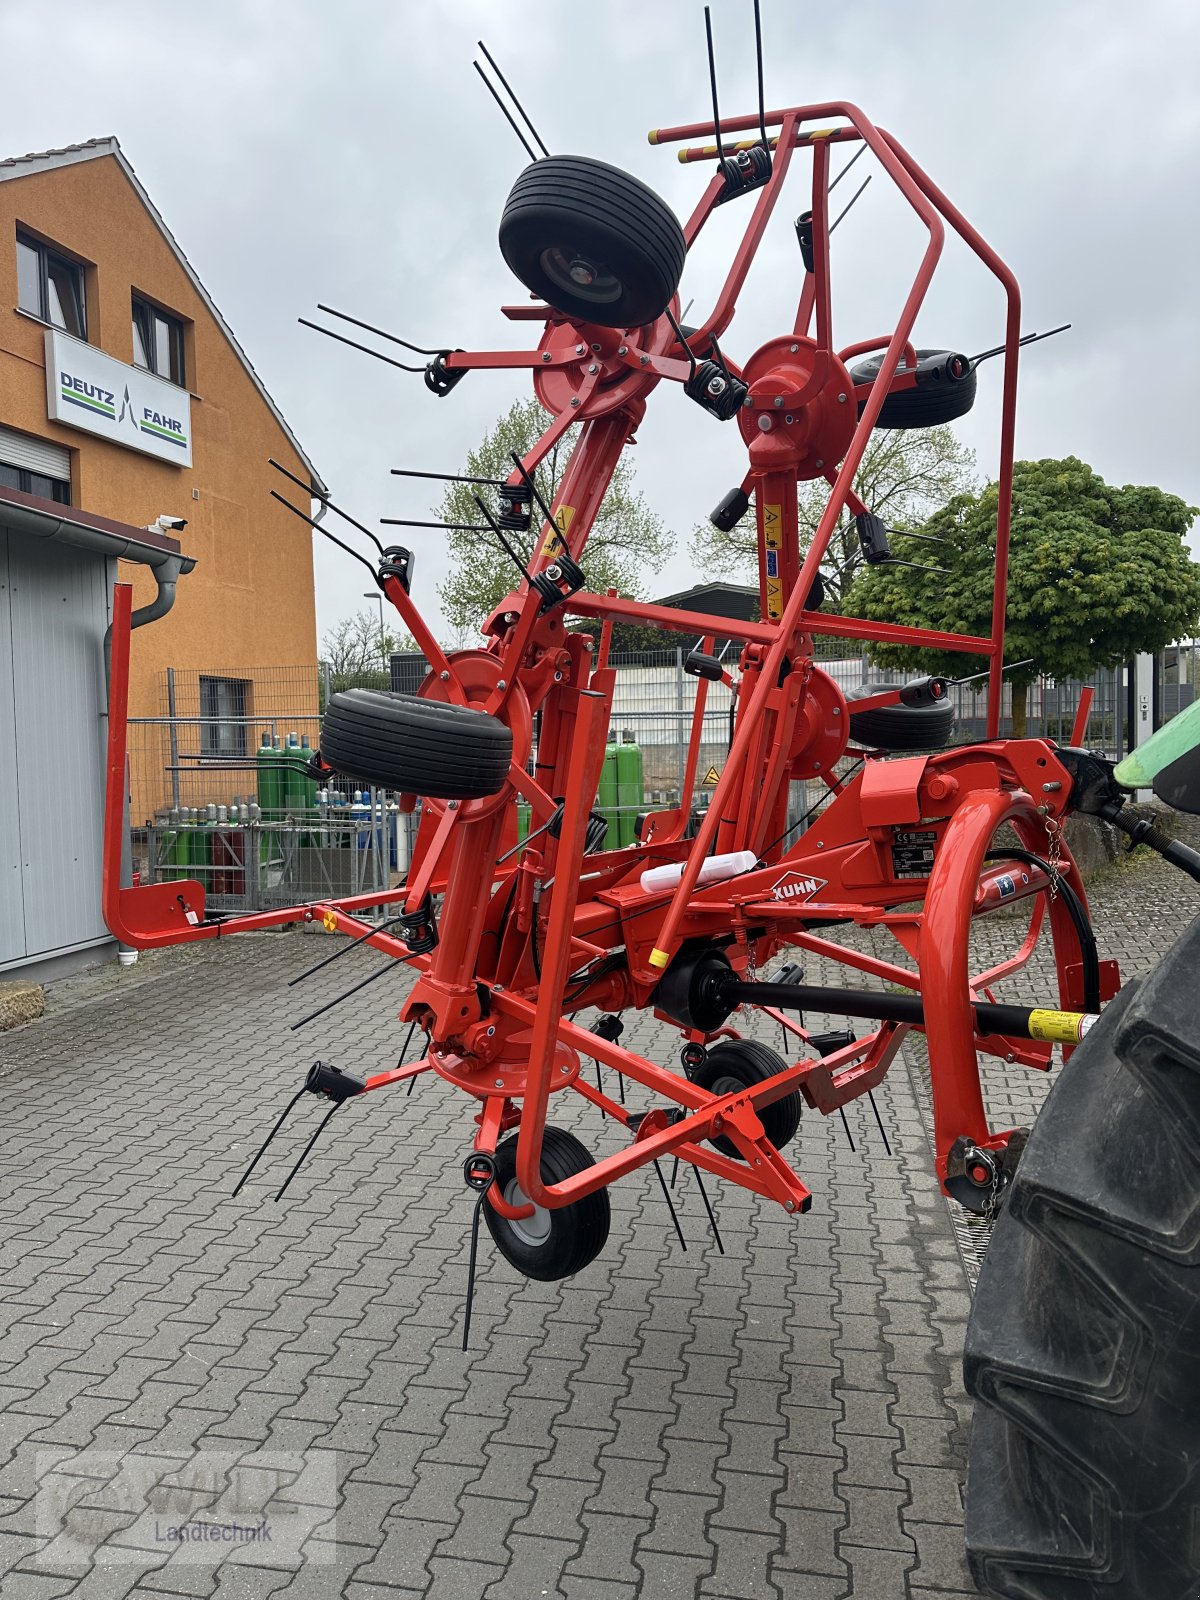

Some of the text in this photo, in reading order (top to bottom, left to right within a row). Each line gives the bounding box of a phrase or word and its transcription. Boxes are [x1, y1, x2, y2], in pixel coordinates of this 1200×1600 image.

[61, 372, 182, 433] DEUTZ FAHR
[773, 879, 817, 900] KUHN
